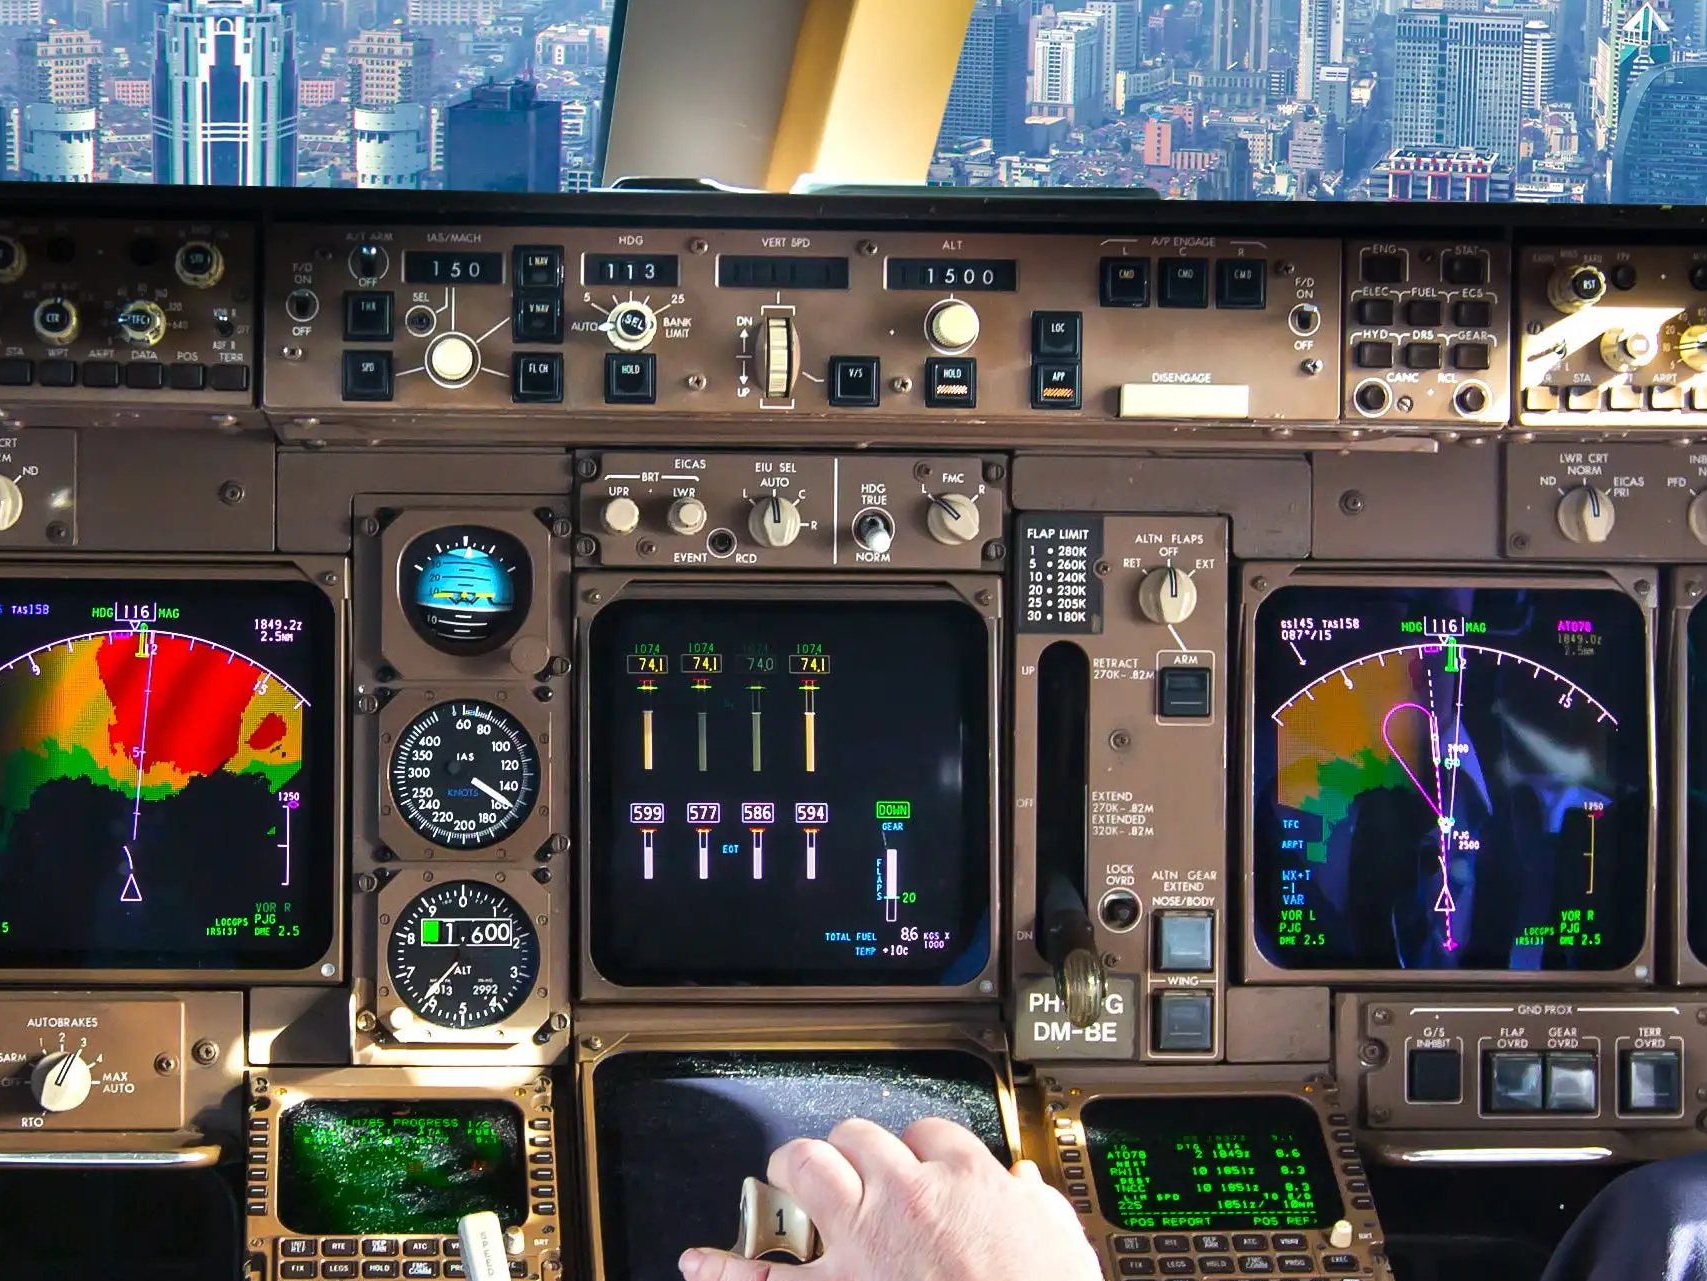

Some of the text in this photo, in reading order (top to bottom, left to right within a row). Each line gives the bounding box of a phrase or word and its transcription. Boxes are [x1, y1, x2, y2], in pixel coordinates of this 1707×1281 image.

[427, 232, 482, 244] IAS/MACH
[618, 235, 644, 246] HDG
[761, 236, 811, 248] VERT SPD
[941, 239, 963, 251] ALT
[927, 267, 994, 285] 1500
[1361, 286, 1390, 297] ELEC
[1411, 286, 1438, 298] FUEL
[671, 293, 686, 304] 25
[570, 321, 598, 332] AUTO
[663, 316, 692, 328] BANK
[736, 315, 753, 327] DN
[665, 328, 690, 339] LIMIT
[1362, 328, 1389, 340] HYD
[1457, 330, 1488, 342] GEAR
[1293, 340, 1314, 351] OFF
[130, 349, 159, 361] DATA
[621, 364, 641, 375] HOLD
[943, 368, 962, 379] HOLD
[1151, 372, 1212, 384] DISENGAGE
[1386, 372, 1420, 384] CANC
[674, 458, 707, 470] EICAS
[1559, 452, 1609, 464] LWR CRT
[755, 462, 797, 474] EIU SEL
[1567, 464, 1603, 476] NORM
[641, 471, 660, 482] BRT
[759, 476, 791, 489] AUTO
[942, 472, 965, 484] FMC
[608, 486, 630, 497] UPR
[671, 487, 696, 499] LWR
[861, 483, 887, 494] HDG
[860, 494, 888, 506] TRUE
[1027, 528, 1090, 540] FLAP LIMIT
[1134, 533, 1204, 545] ALTN FLAPS
[855, 551, 892, 563] NORM
[1029, 545, 1088, 557] 1 280K
[1158, 546, 1179, 557] OFF
[673, 552, 708, 563] EVENT
[735, 552, 758, 564] RCD
[1123, 557, 1142, 569] RET
[1029, 557, 1087, 571] 5 260K
[1195, 558, 1215, 570] EXT
[1029, 571, 1087, 584] 10 240K
[1028, 584, 1087, 597] 20 230K
[1027, 596, 1087, 610] 25 205K
[91, 604, 180, 619] HDG 116 MAG
[1027, 609, 1086, 623] 30 180K
[1092, 657, 1139, 669] RETRACT
[1173, 654, 1198, 665] ARM
[1021, 665, 1036, 676] UP
[455, 718, 472, 730] 60
[476, 723, 492, 736] 80
[418, 735, 441, 747] 400
[491, 740, 511, 753] 100
[411, 749, 434, 762] 350
[456, 752, 475, 762] IAS
[500, 759, 520, 771] 120
[407, 767, 431, 779] 300
[499, 780, 519, 792] 140
[411, 786, 434, 799] 250
[1091, 790, 1133, 802] EXTEND
[418, 798, 441, 810] 240
[879, 804, 907, 816] DOWN
[431, 810, 454, 823] 220
[478, 812, 497, 824] 180
[633, 806, 662, 820] 599
[690, 806, 717, 820] 577
[744, 806, 771, 820] 586
[798, 806, 825, 820] 594
[1091, 813, 1147, 825] EXTENDED
[453, 819, 476, 831] 200
[1106, 863, 1134, 875] LOCK
[1151, 869, 1218, 881] ALTN GEAR
[1105, 875, 1135, 886] OVRD
[1163, 881, 1205, 892] EXTEND
[902, 891, 917, 904] 20
[1151, 895, 1216, 907] NOSE/BODY
[1016, 930, 1034, 941] DN
[453, 965, 472, 976] ALT
[1167, 975, 1200, 987] WING
[1517, 1003, 1573, 1016] GND PROX
[26, 1016, 99, 1028] AUTOBRAKES
[1033, 1021, 1118, 1043] DM-BE
[1500, 1027, 1525, 1038] FLAP
[1548, 1026, 1577, 1038] GEAR
[1638, 1026, 1662, 1038] TERR
[1496, 1038, 1529, 1049] OVRD
[1547, 1038, 1579, 1049] OVRD
[1634, 1037, 1666, 1049] OVRD
[102, 1071, 128, 1082] MAX
[102, 1082, 135, 1094] AUTO
[21, 1116, 45, 1128] RTO
[1161, 1216, 1211, 1227] REPORT
